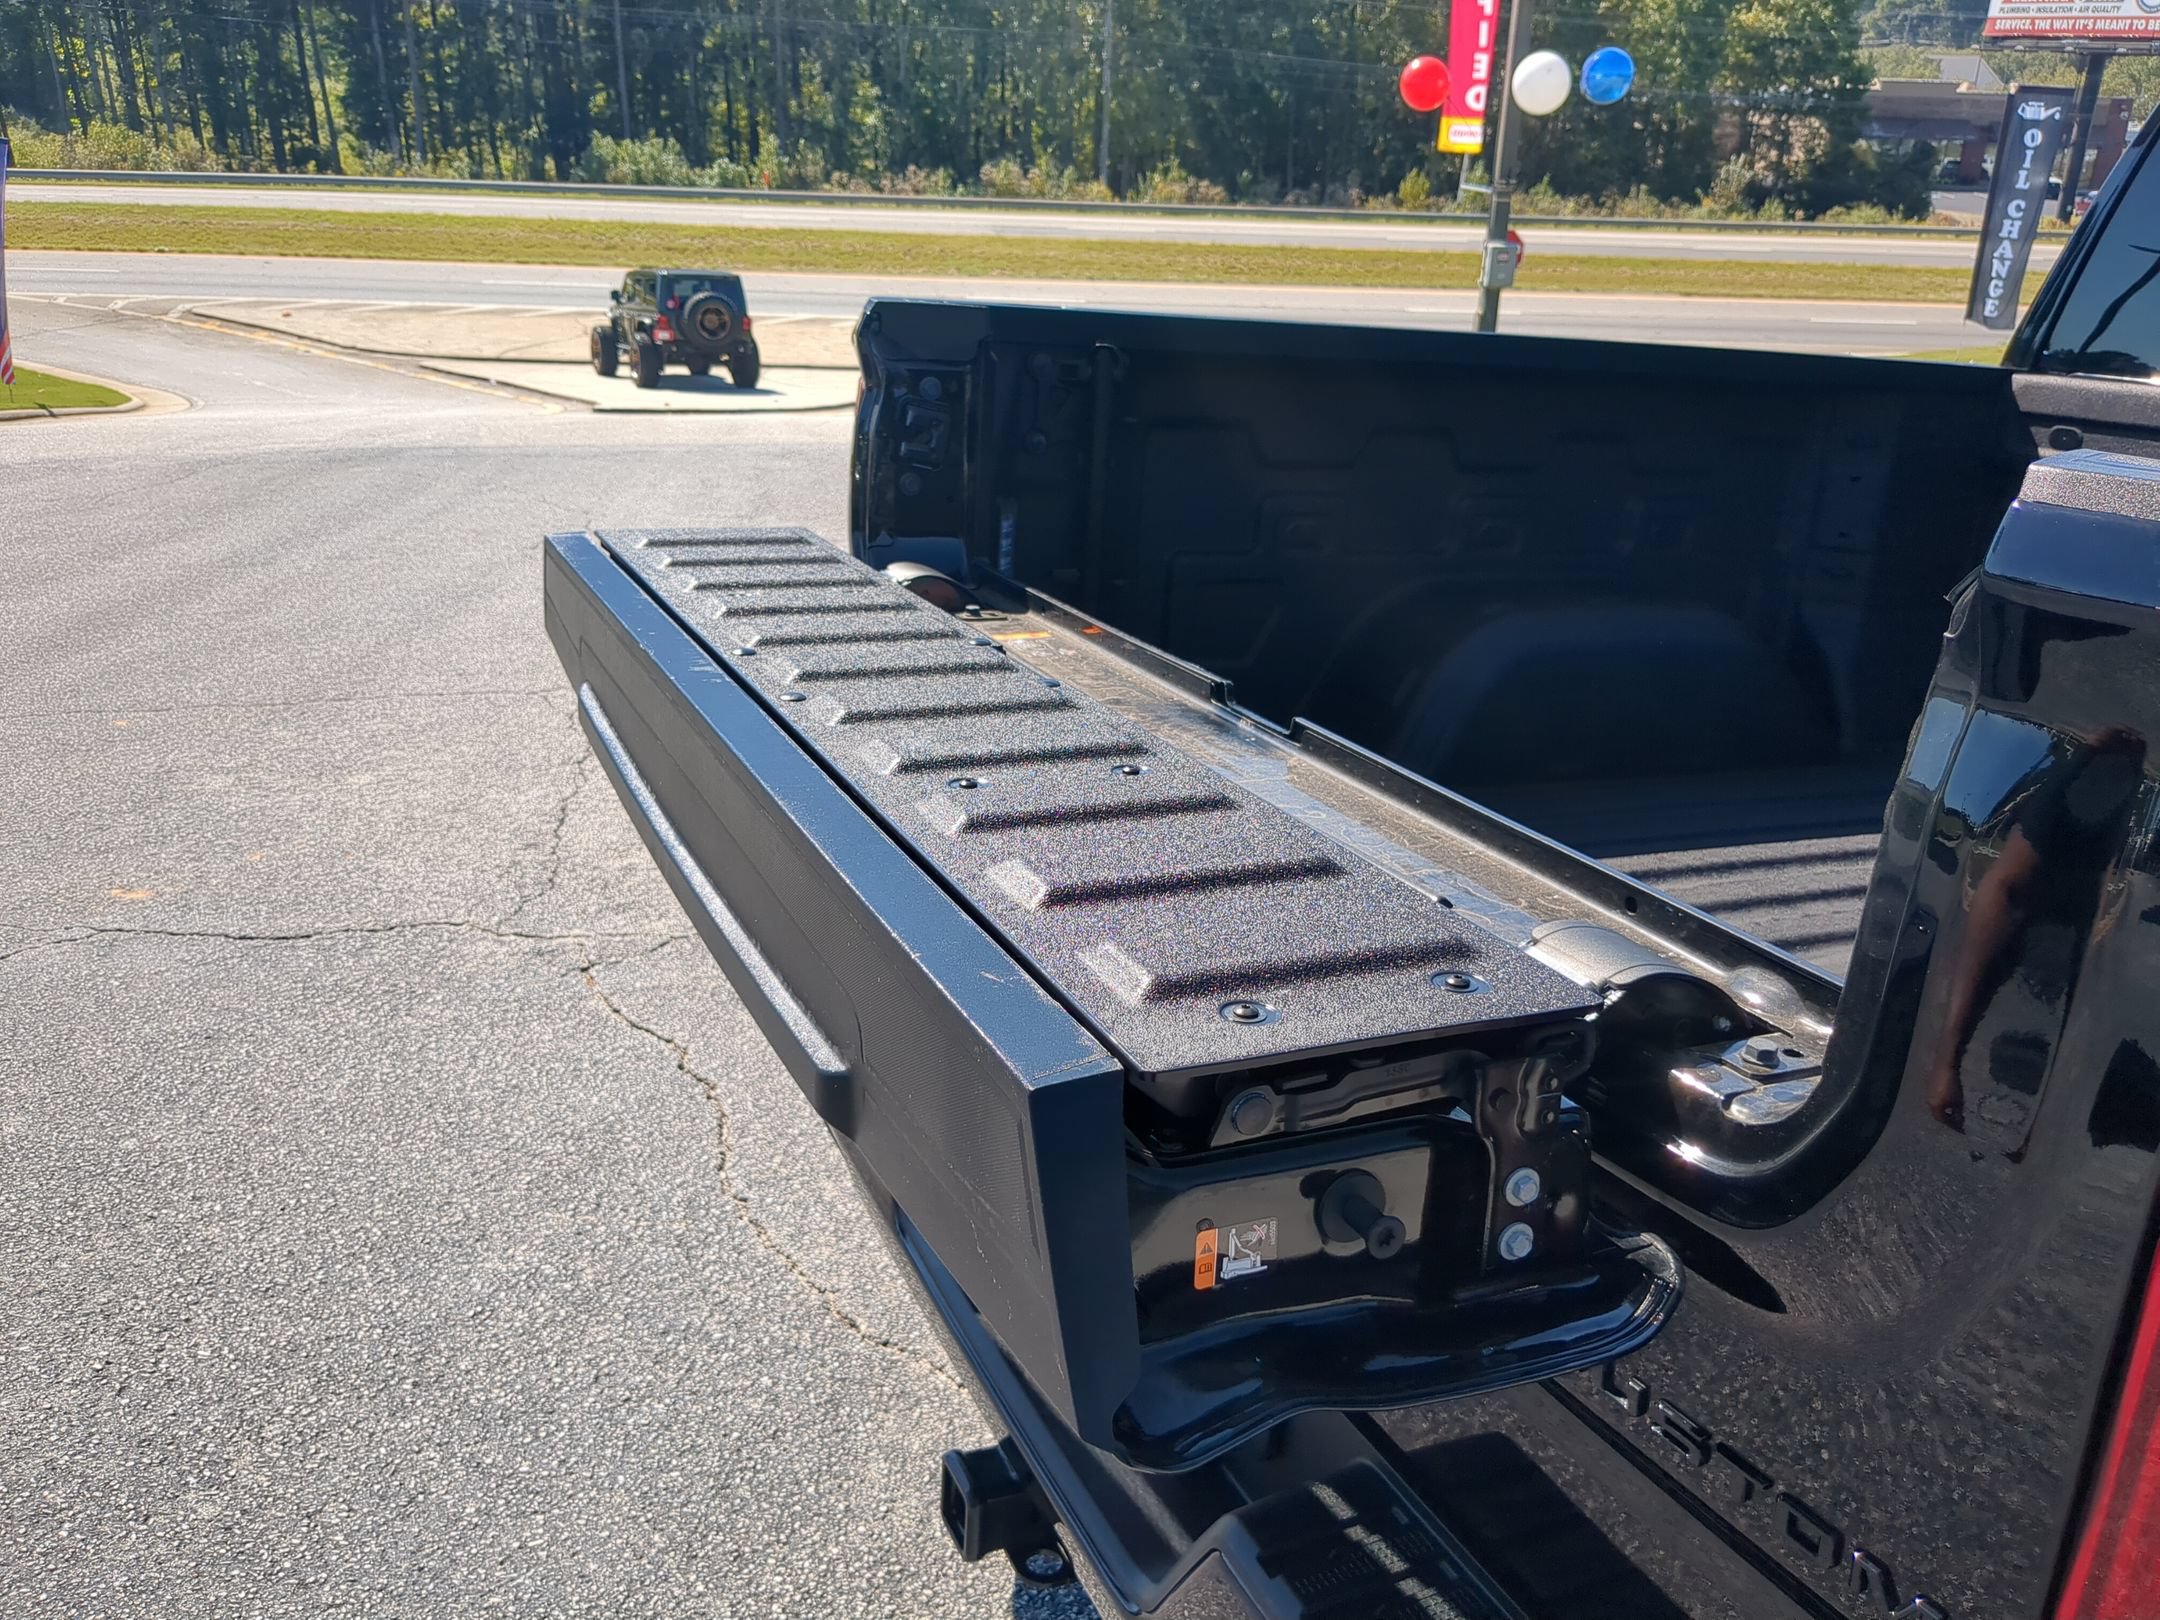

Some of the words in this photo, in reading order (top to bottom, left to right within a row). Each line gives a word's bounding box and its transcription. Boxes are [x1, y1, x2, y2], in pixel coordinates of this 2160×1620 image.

[1998, 6, 2031, 14] PLUMBING
[2035, 6, 2073, 14] INSULATION
[2078, 5, 2090, 13] AIR
[2091, 5, 2122, 14] QUALITY
[2034, 19, 2051, 30] THE
[2052, 19, 2075, 30] WAY
[2075, 19, 2094, 30] IT'S
[2095, 19, 2131, 30] MEANT
[2132, 19, 2148, 30] TO
[2015, 127, 2043, 191] OIL
[1982, 199, 2027, 318] CHANGE
